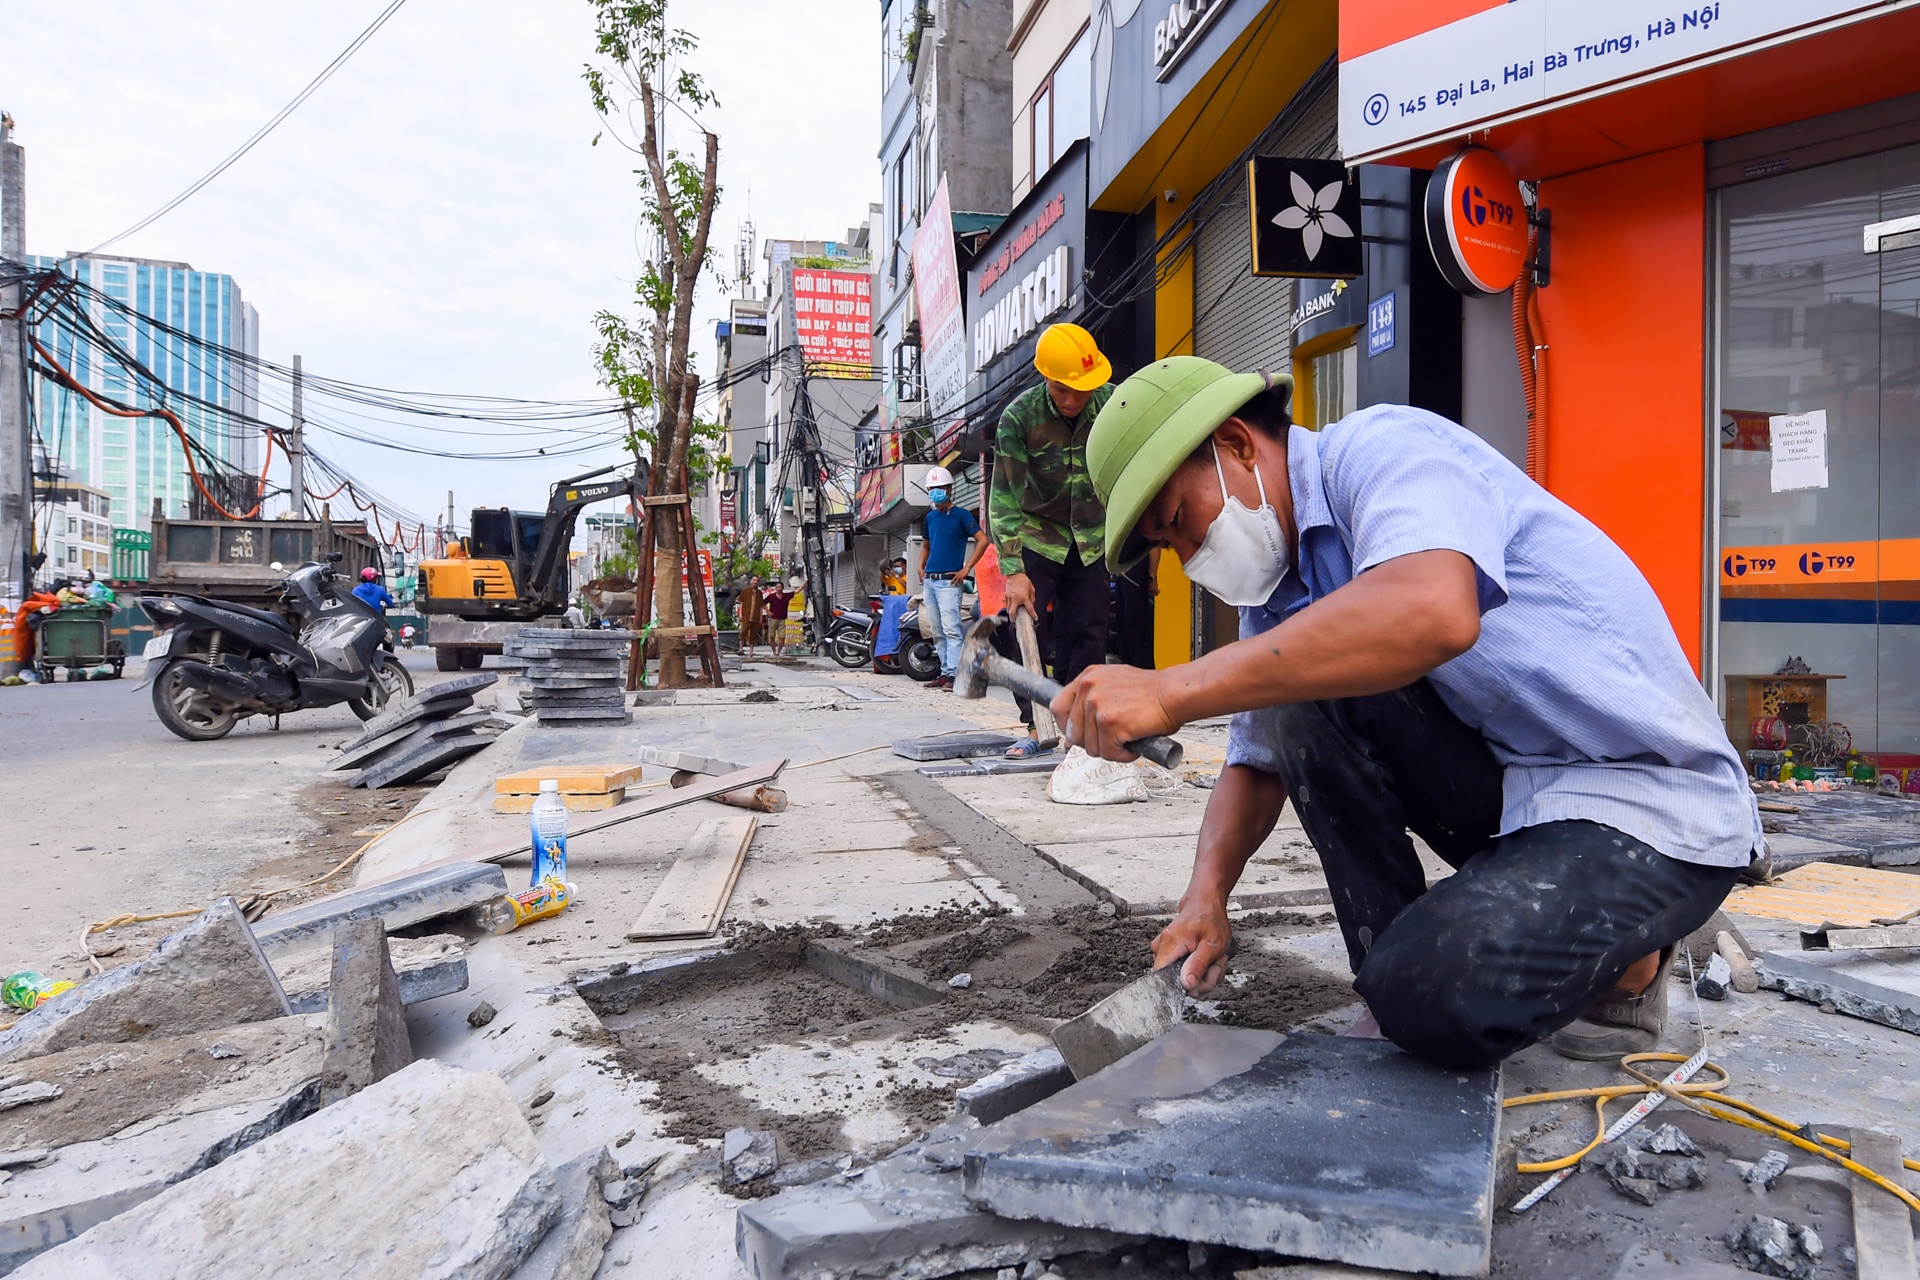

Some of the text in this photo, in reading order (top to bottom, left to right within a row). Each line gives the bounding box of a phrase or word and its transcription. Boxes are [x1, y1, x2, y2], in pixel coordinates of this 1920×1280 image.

[1399, 2, 1720, 117] 145 Đại La, Hai Bà Trưng, Hà Nội
[1487, 199, 1514, 225] T99
[856, 278, 870, 296] GÓI
[1305, 290, 1336, 316] BANK
[1371, 300, 1393, 333] 143
[581, 486, 609, 498] VOLVO
[1750, 559, 1776, 571] T99
[1826, 556, 1855, 568] T99
